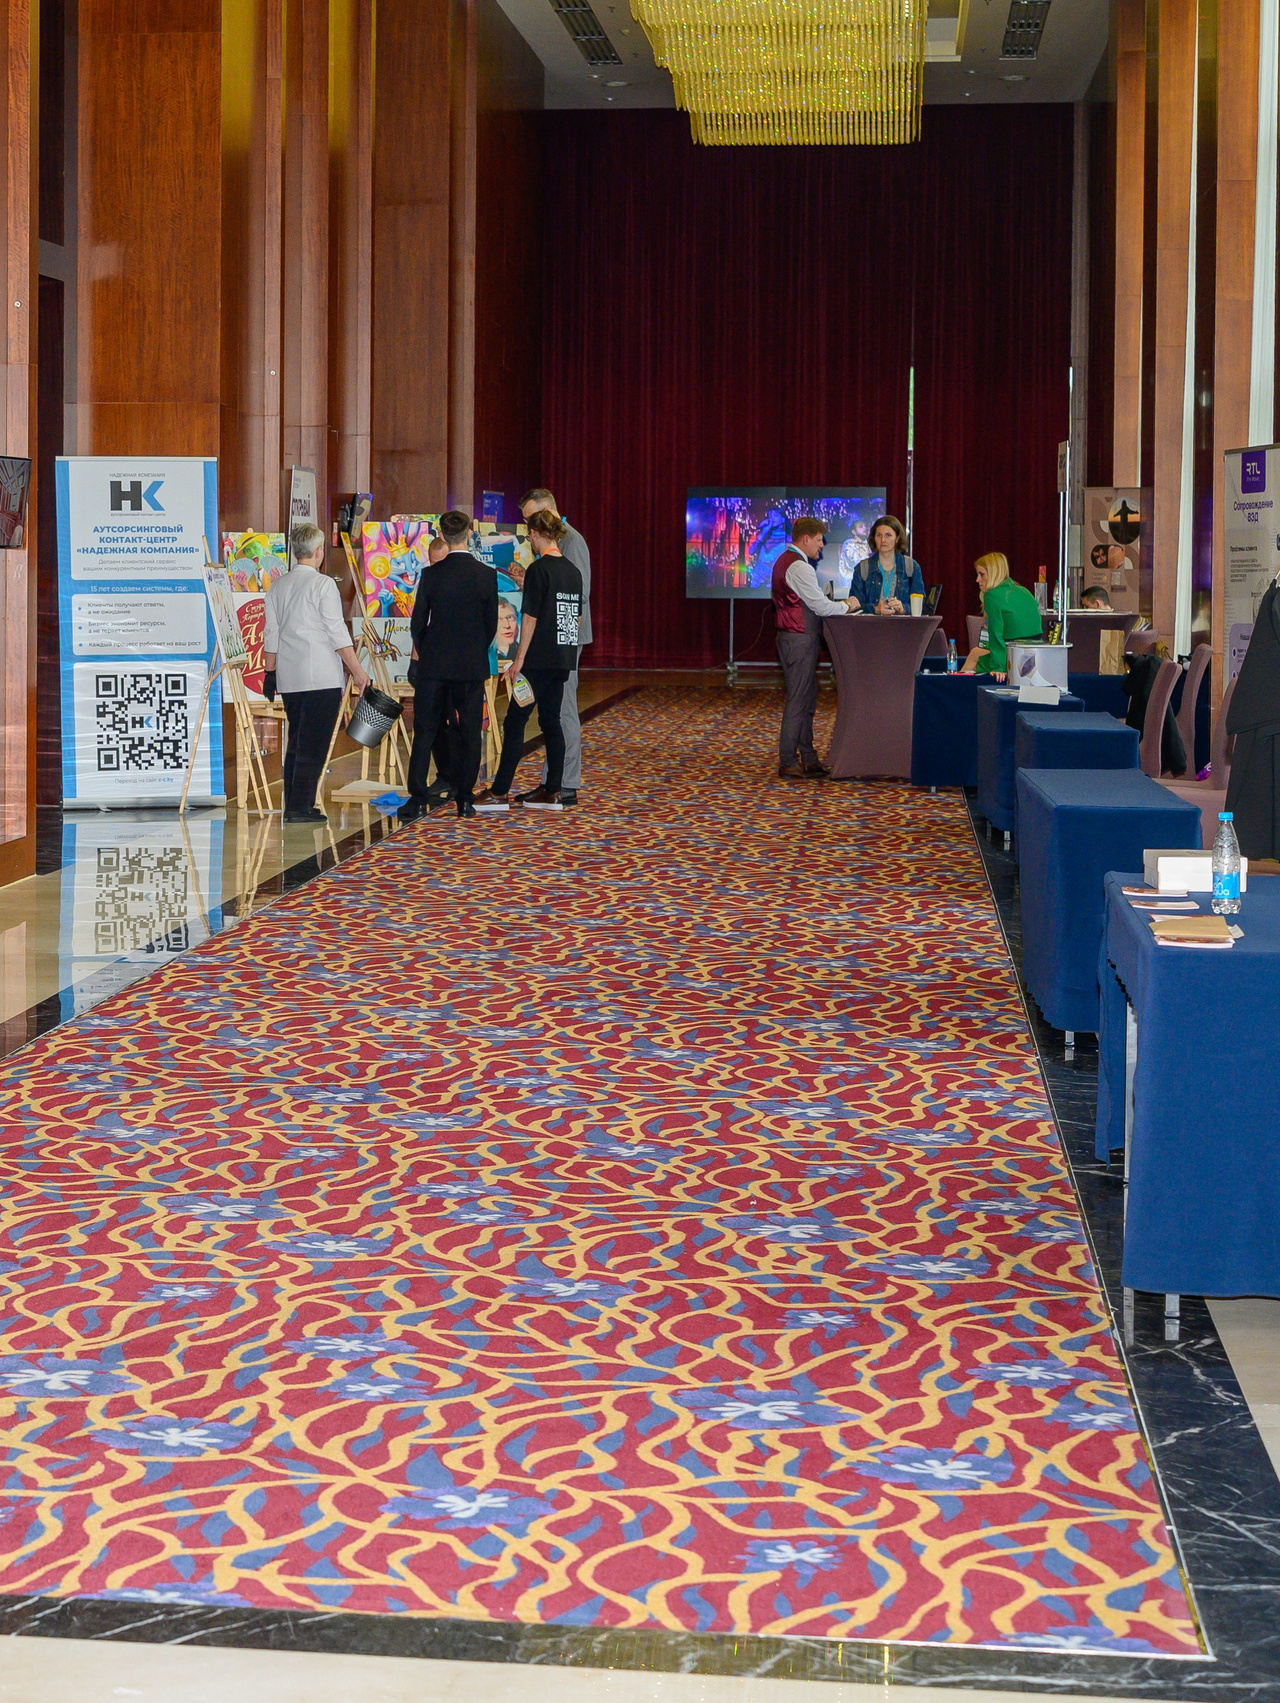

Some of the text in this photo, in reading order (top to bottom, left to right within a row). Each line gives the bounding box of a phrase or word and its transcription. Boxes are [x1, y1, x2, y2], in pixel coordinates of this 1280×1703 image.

[1246, 462, 1260, 475] RTL
[1234, 500, 1273, 511] Сопровождение
[1247, 512, 1259, 523] ВЭД
[93, 524, 183, 533] АУТСОРСИНГОВЫЙ
[99, 536, 178, 544] КОНТАКТ-ЦЕНТР
[76, 546, 200, 555] «НАДЕЖНАЯ КОМПАНИЯ»
[175, 585, 189, 593] где:
